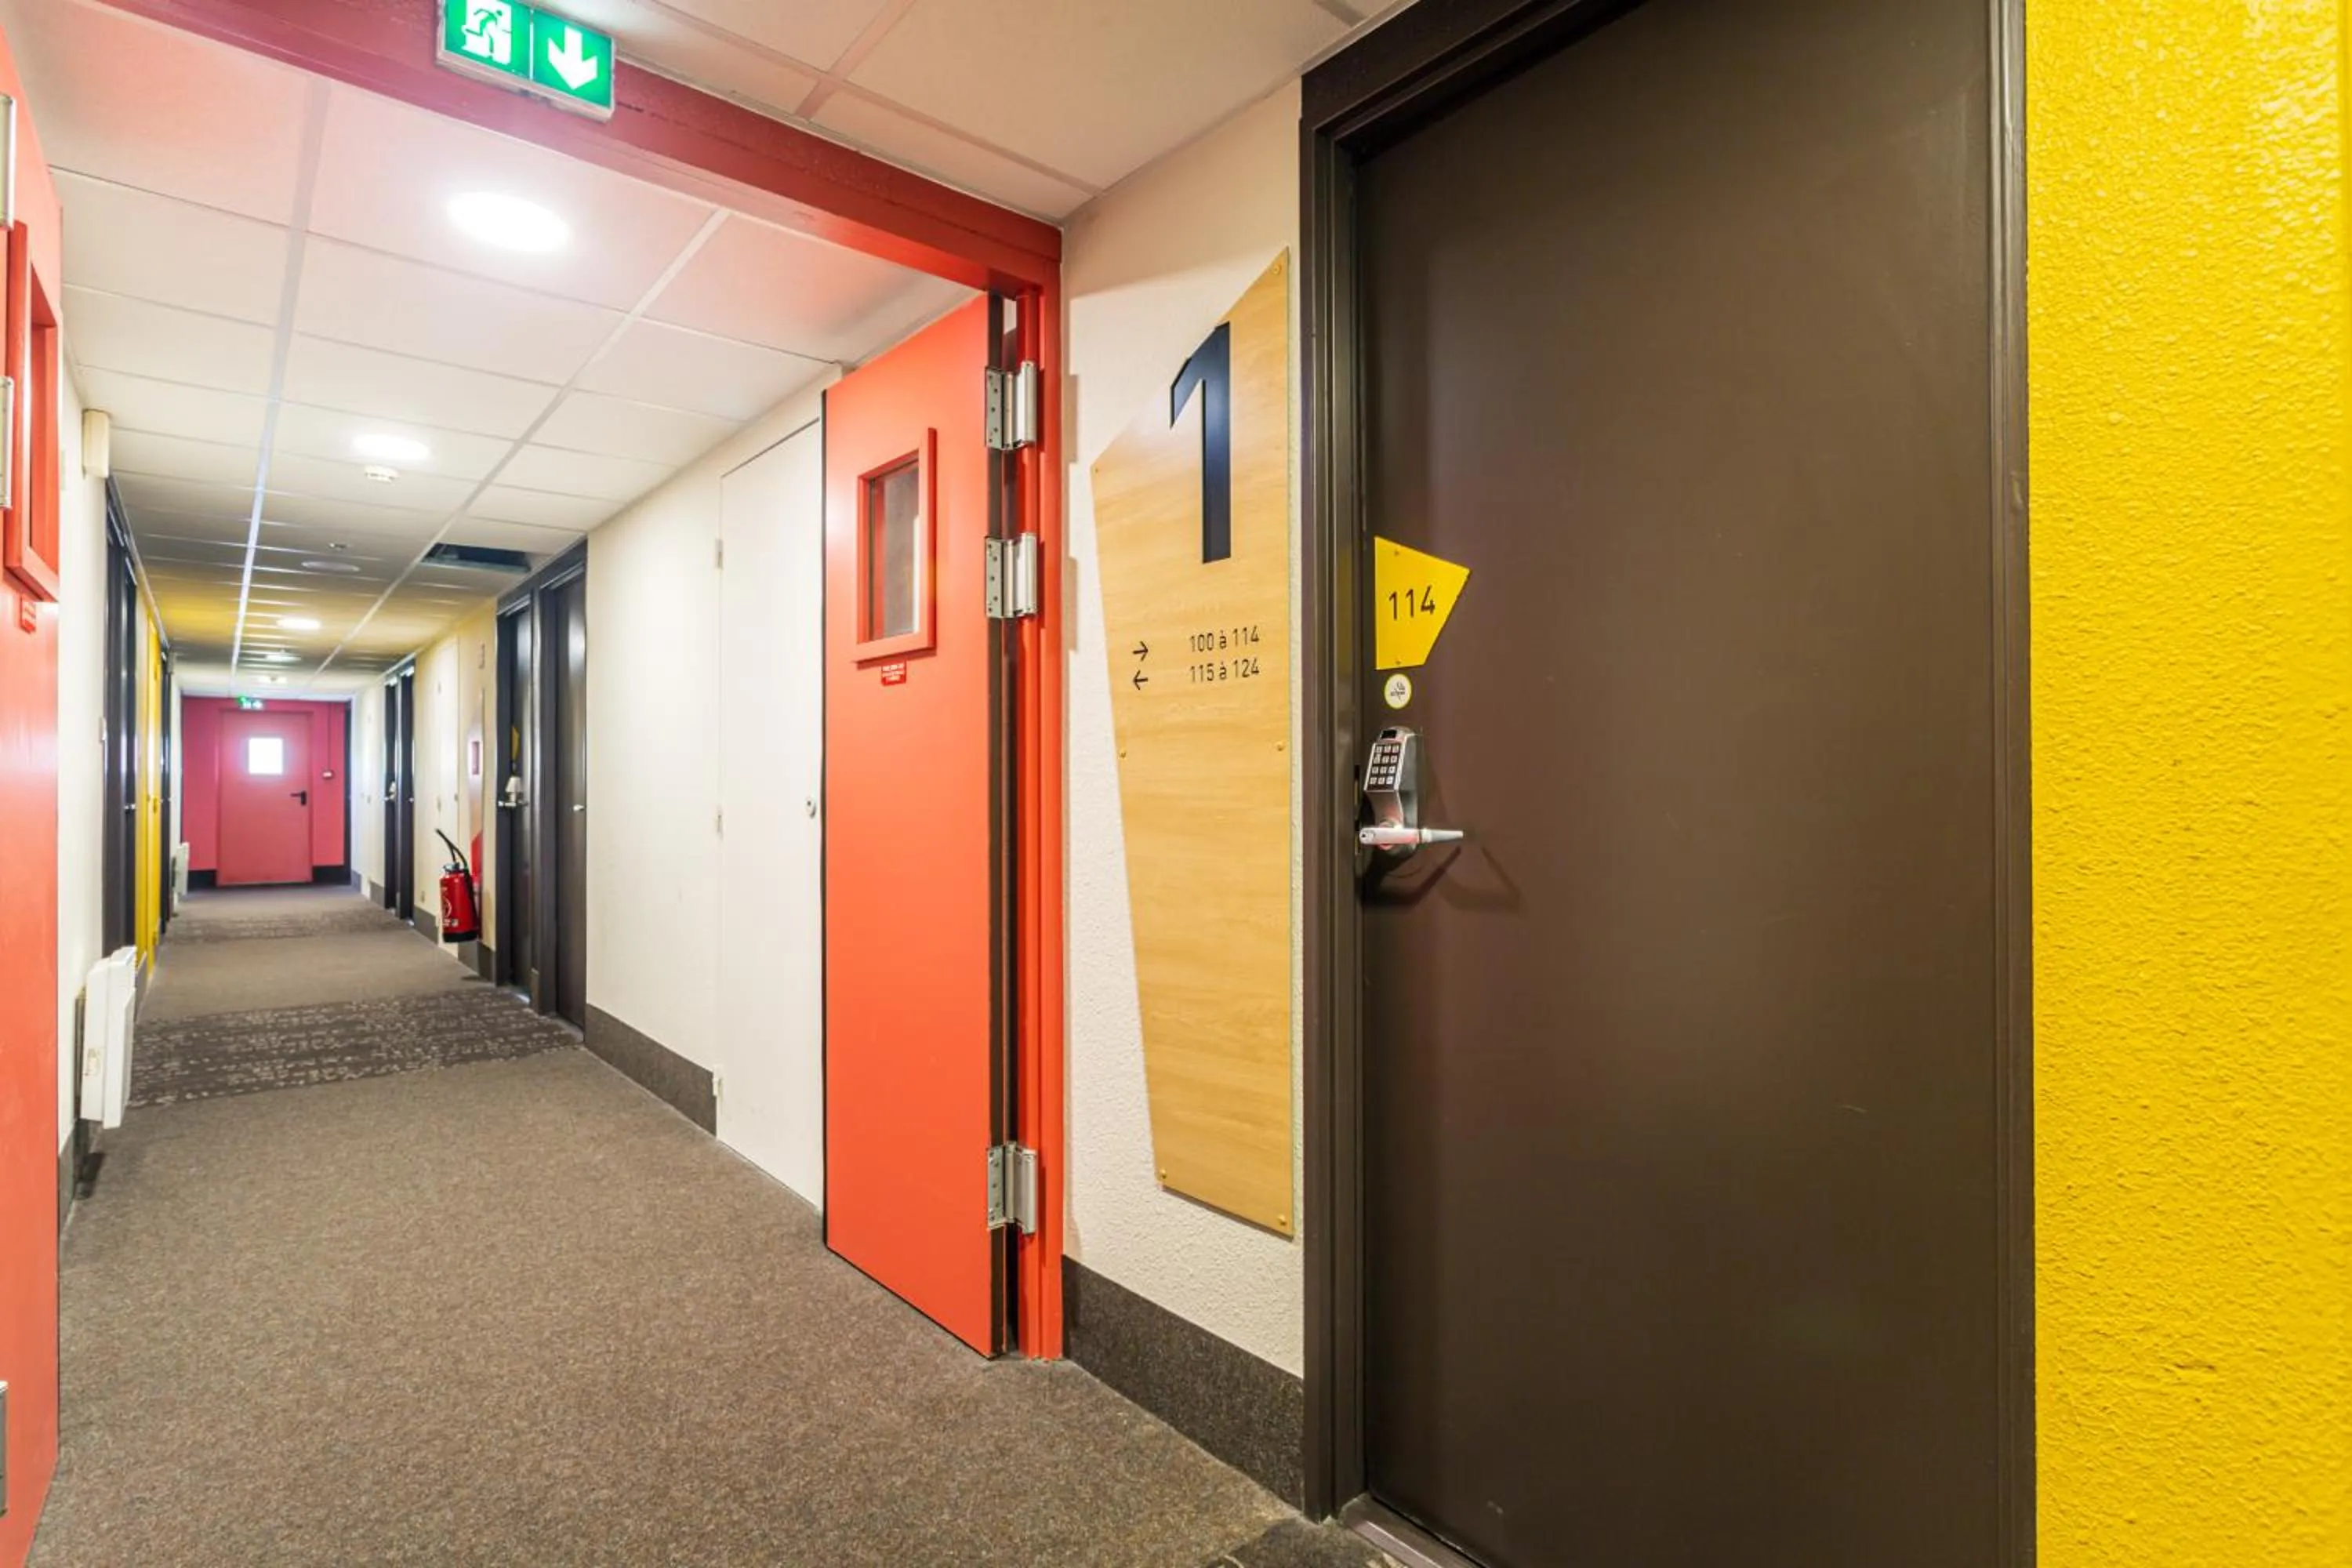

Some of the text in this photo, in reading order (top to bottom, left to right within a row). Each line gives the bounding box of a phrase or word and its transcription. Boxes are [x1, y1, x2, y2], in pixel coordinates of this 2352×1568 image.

[1170, 321, 1231, 564] 1
[1388, 585, 1436, 620] 114
[1190, 633, 1214, 652] 100
[1232, 625, 1259, 646] 114
[1190, 663, 1214, 683] 115
[1232, 658, 1259, 678] 124
